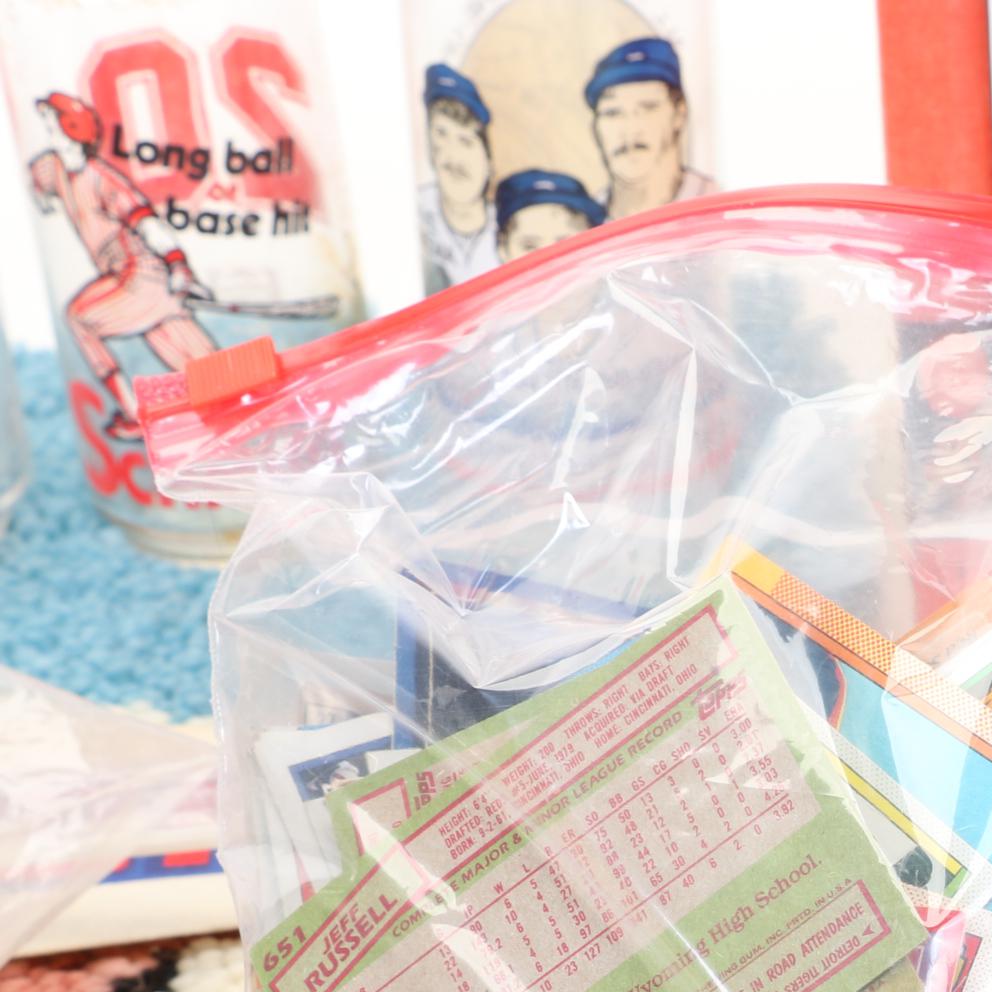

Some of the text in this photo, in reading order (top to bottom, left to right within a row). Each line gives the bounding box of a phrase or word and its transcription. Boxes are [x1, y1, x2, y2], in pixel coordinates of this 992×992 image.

[112, 124, 294, 180] Long ball
[166, 198, 309, 236] base hit
[644, 664, 676, 692] DRAFT
[674, 663, 699, 685] OHIO
[436, 806, 473, 837] HEIGHT:
[562, 705, 602, 739] THROWS:
[600, 684, 630, 710] RIGHT
[662, 635, 692, 662] RIGHT
[458, 708, 686, 885] MAJOR LEAGUE RECORD
[705, 901, 758, 948] High
[751, 849, 823, 910] School.
[263, 925, 308, 972] 651
[321, 901, 363, 955] JEFF
[763, 950, 799, 981] ROAD
[796, 900, 866, 957] ATTENDANCE
[817, 933, 862, 971] DETROIT
